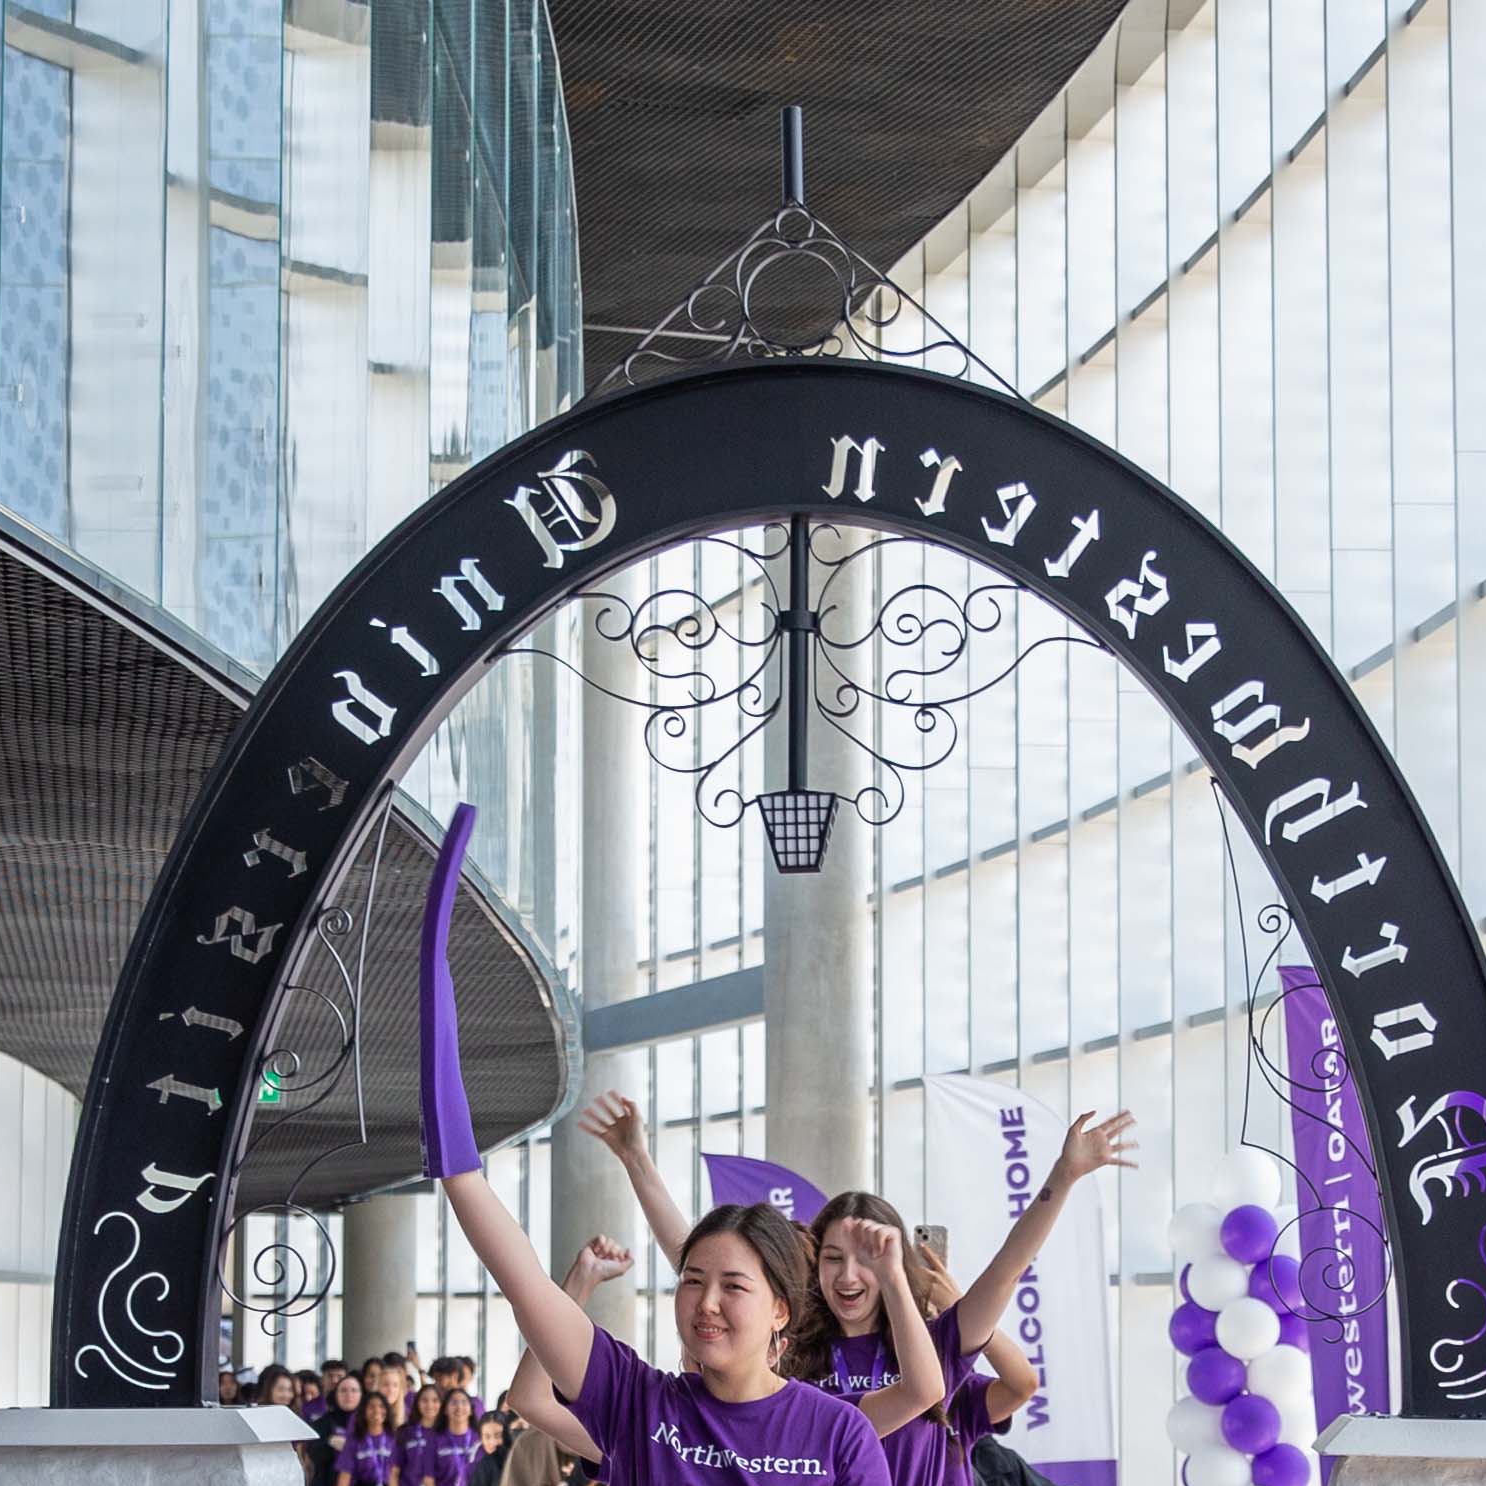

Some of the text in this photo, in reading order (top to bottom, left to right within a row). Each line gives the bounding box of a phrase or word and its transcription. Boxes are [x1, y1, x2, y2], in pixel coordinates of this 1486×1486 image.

[999, 1106, 1032, 1219] HOME
[1320, 1018, 1367, 1414] western QATAR
